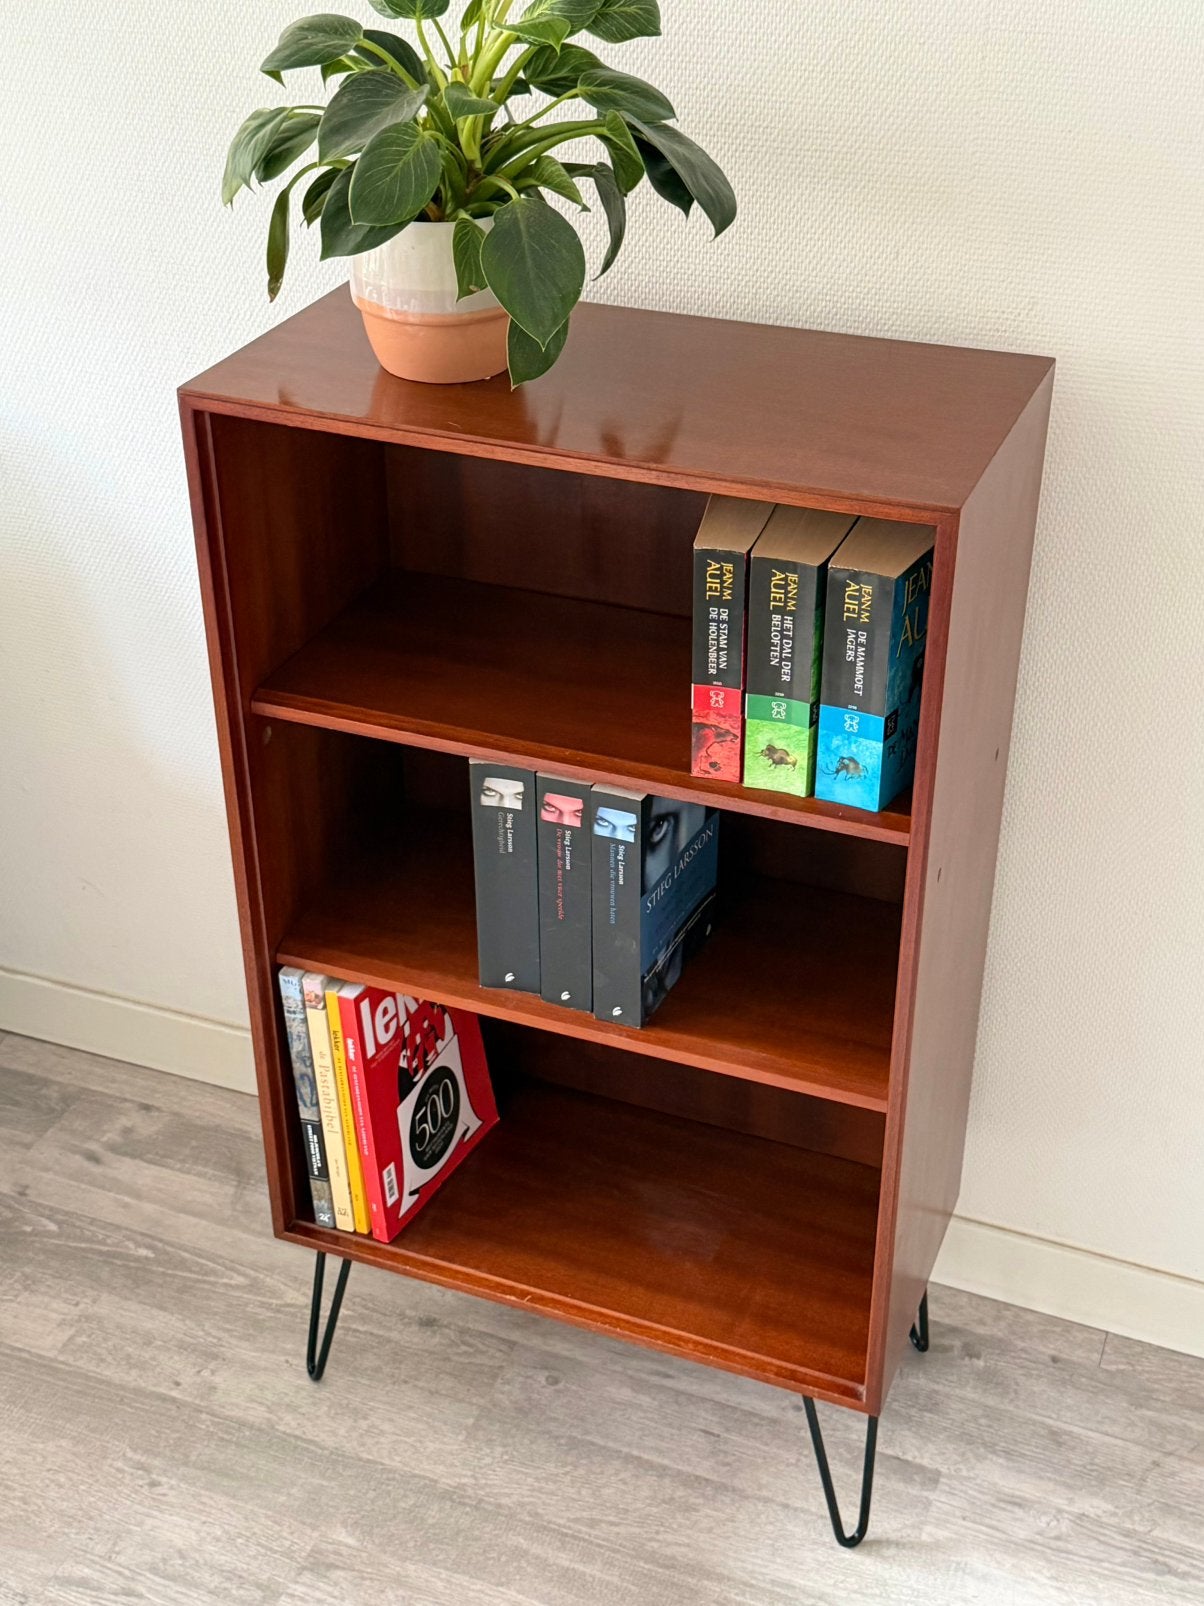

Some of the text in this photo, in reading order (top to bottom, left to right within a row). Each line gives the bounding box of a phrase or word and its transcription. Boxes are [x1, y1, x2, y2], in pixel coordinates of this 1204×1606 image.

[706, 559, 720, 600] AUEL
[721, 562, 733, 600] JEAN M
[770, 569, 785, 610] AUEL
[786, 572, 799, 611] JEAN M
[843, 579, 860, 621] AUEL
[709, 607, 718, 620] DE
[860, 583, 872, 623] JEAN M
[708, 622, 718, 675] HOLENBEER
[719, 608, 728, 669] DE STAM VAN
[770, 614, 781, 666] BELOFTEN
[781, 615, 793, 682] HET DAL DER
[846, 628, 856, 662] JAGERS
[854, 631, 867, 696] DE MAMMOET
[505, 813, 513, 828] Stieg
[563, 830, 571, 845] Stieg
[617, 845, 625, 860] Stieg
[646, 824, 714, 913] STIEG LARSSON
[333, 1030, 341, 1051] lekker
[319, 1051, 339, 1134] de Pastabijbel
[415, 1079, 454, 1151] 500
